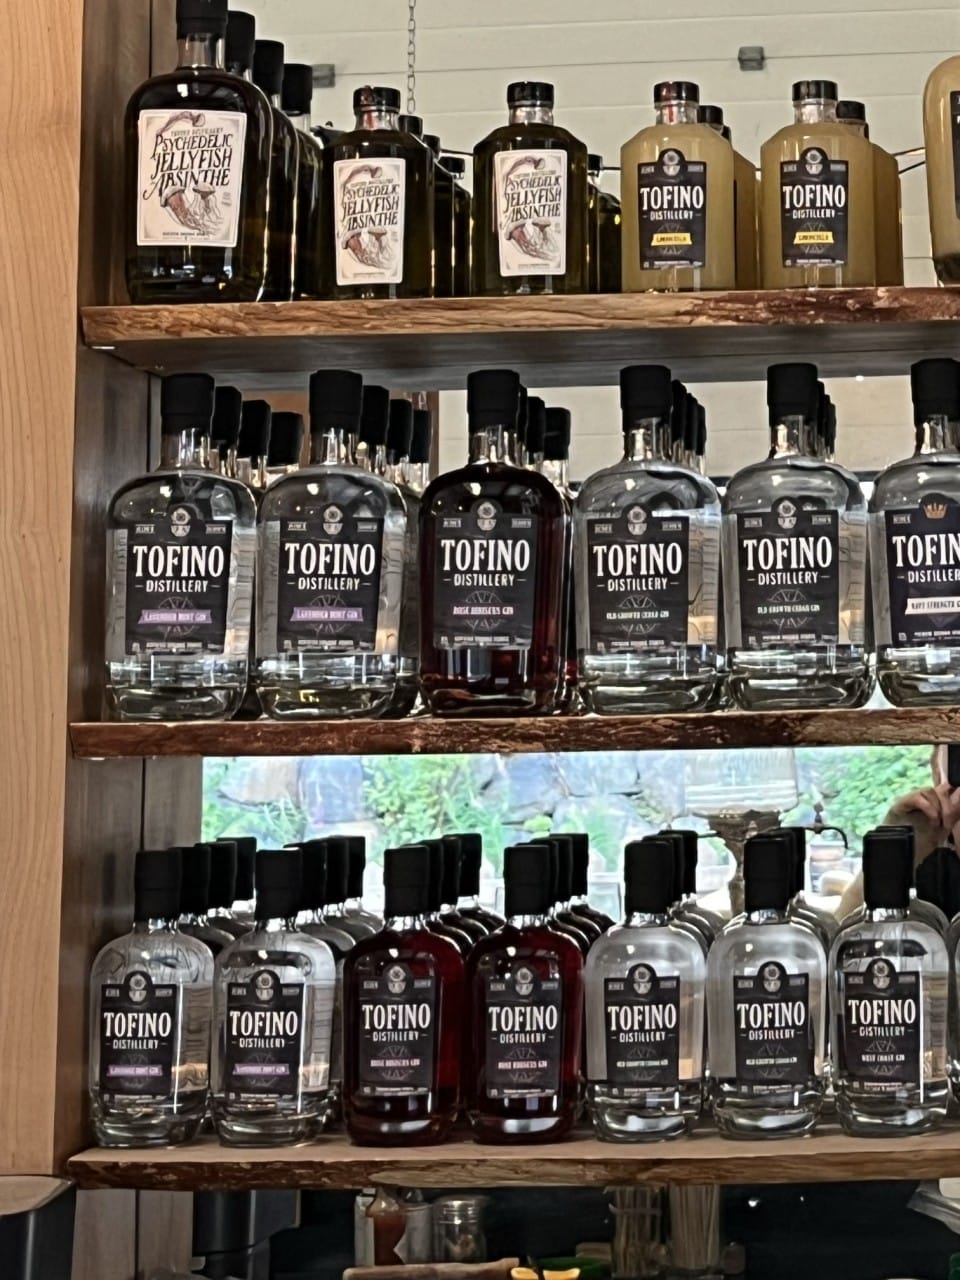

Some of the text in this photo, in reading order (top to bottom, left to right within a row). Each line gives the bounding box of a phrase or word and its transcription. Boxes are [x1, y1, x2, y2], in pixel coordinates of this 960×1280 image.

[151, 133, 233, 160] PSYCHEDELIC
[151, 148, 232, 179] JELLYFISH
[143, 169, 230, 200] ABSINTHE
[783, 184, 845, 209] TOFINO
[342, 196, 399, 222] JELLYFISH
[503, 188, 561, 213] JELLYFISH
[640, 186, 704, 210] TOFINO
[650, 210, 693, 220] DISTILLERY
[793, 209, 835, 219] DISTILLERY
[133, 545, 224, 577] TOFINO
[285, 543, 375, 575] TOFINO
[441, 539, 530, 571] TOFINO
[593, 543, 682, 576] TOFINO
[744, 536, 832, 570] TOFINO
[146, 580, 208, 593] DISTILLERY
[298, 577, 360, 590] DISTILLERY
[454, 574, 515, 586] DISTILLERY
[608, 578, 667, 591] DISTILLERY
[758, 572, 818, 585] DISTILLERY
[230, 1011, 297, 1036] TOFINO
[362, 1003, 430, 1030] TOFINO
[489, 1005, 557, 1032] TOFINO
[608, 1004, 677, 1031] TOFINO
[737, 1002, 805, 1028] TOFINO
[848, 999, 916, 1025] TOFINO
[104, 1012, 171, 1038] TOFINO
[373, 1031, 419, 1042] DISTILLERY
[620, 1031, 665, 1043] DISTILLERY
[749, 1029, 794, 1041] DISTILLERY
[860, 1026, 905, 1037] DISTILLERY
[113, 1039, 158, 1050] DISTILLERY
[239, 1038, 285, 1048] DISTILLERY
[500, 1033, 546, 1043] DISTILLERY
